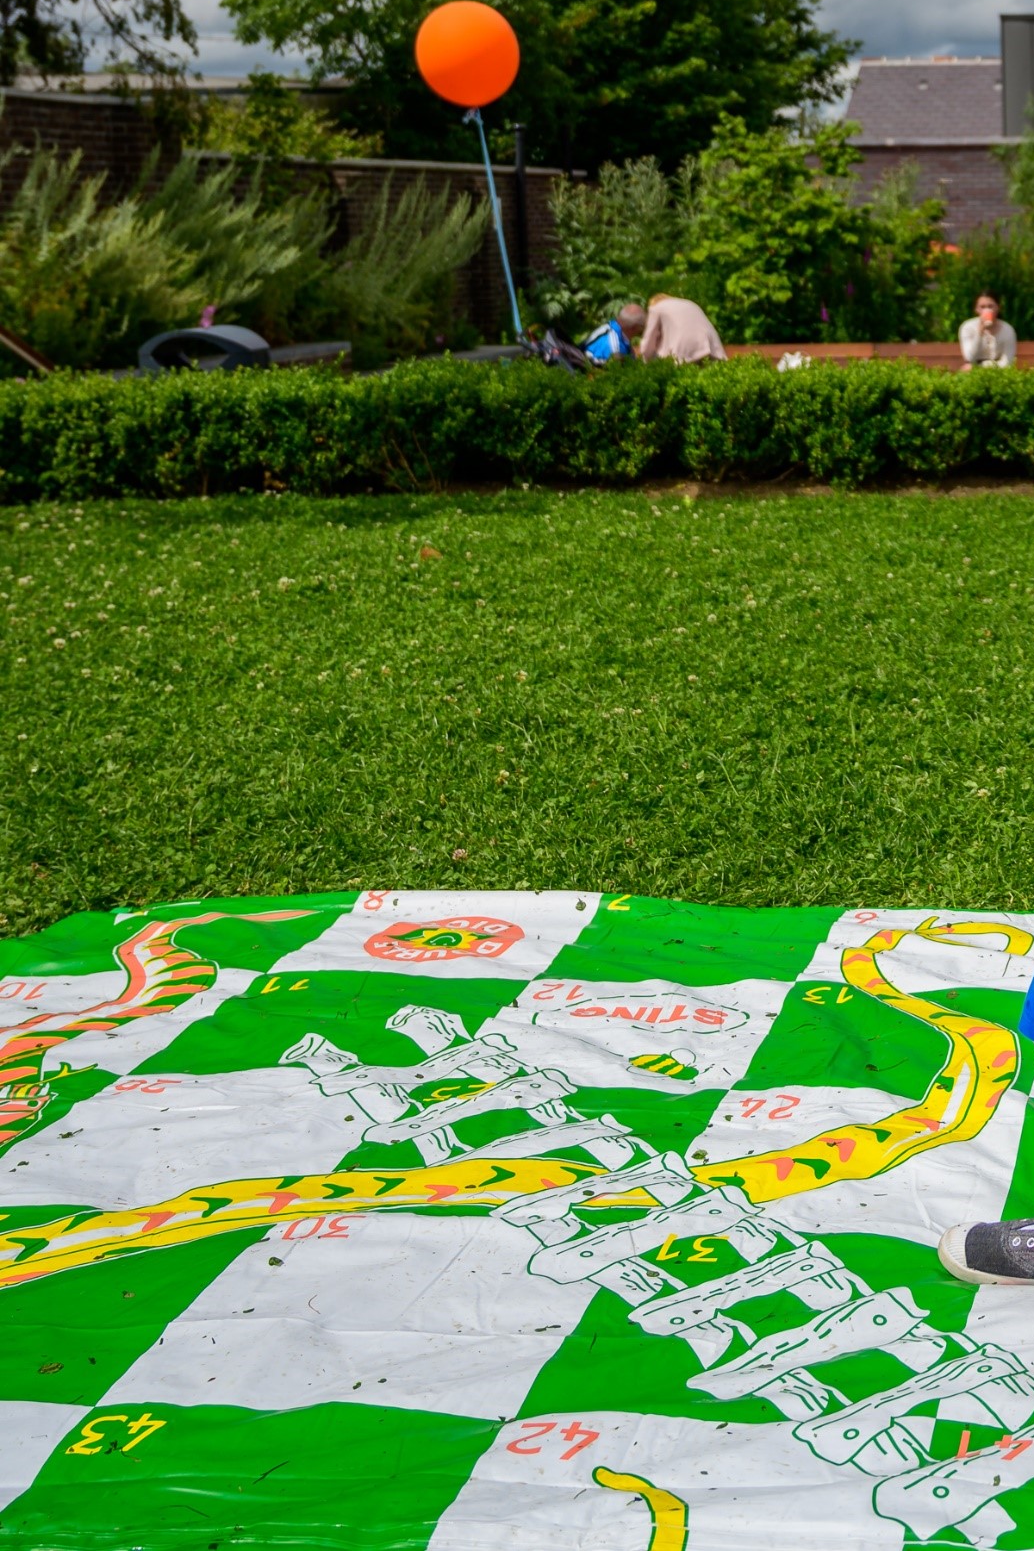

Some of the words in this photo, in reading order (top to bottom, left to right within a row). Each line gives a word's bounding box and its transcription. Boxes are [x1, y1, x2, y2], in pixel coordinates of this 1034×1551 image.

[364, 890, 392, 911] 8
[607, 894, 631, 910] 7
[420, 919, 507, 933] DIC
[854, 912, 878, 924] 6
[374, 941, 503, 958] DUBLE
[0, 981, 46, 1001] 10
[261, 977, 309, 994] 11
[532, 982, 583, 1002] 12
[803, 983, 853, 1004] 13
[571, 1005, 728, 1026] STING
[113, 1079, 181, 1095] 26
[425, 1081, 499, 1103] 25
[740, 1094, 802, 1121] 24
[280, 1213, 366, 1242] 30
[656, 1233, 731, 1263] 31
[65, 1412, 167, 1456] 43
[505, 1420, 600, 1461] 42
[954, 1430, 1034, 1461] 41
